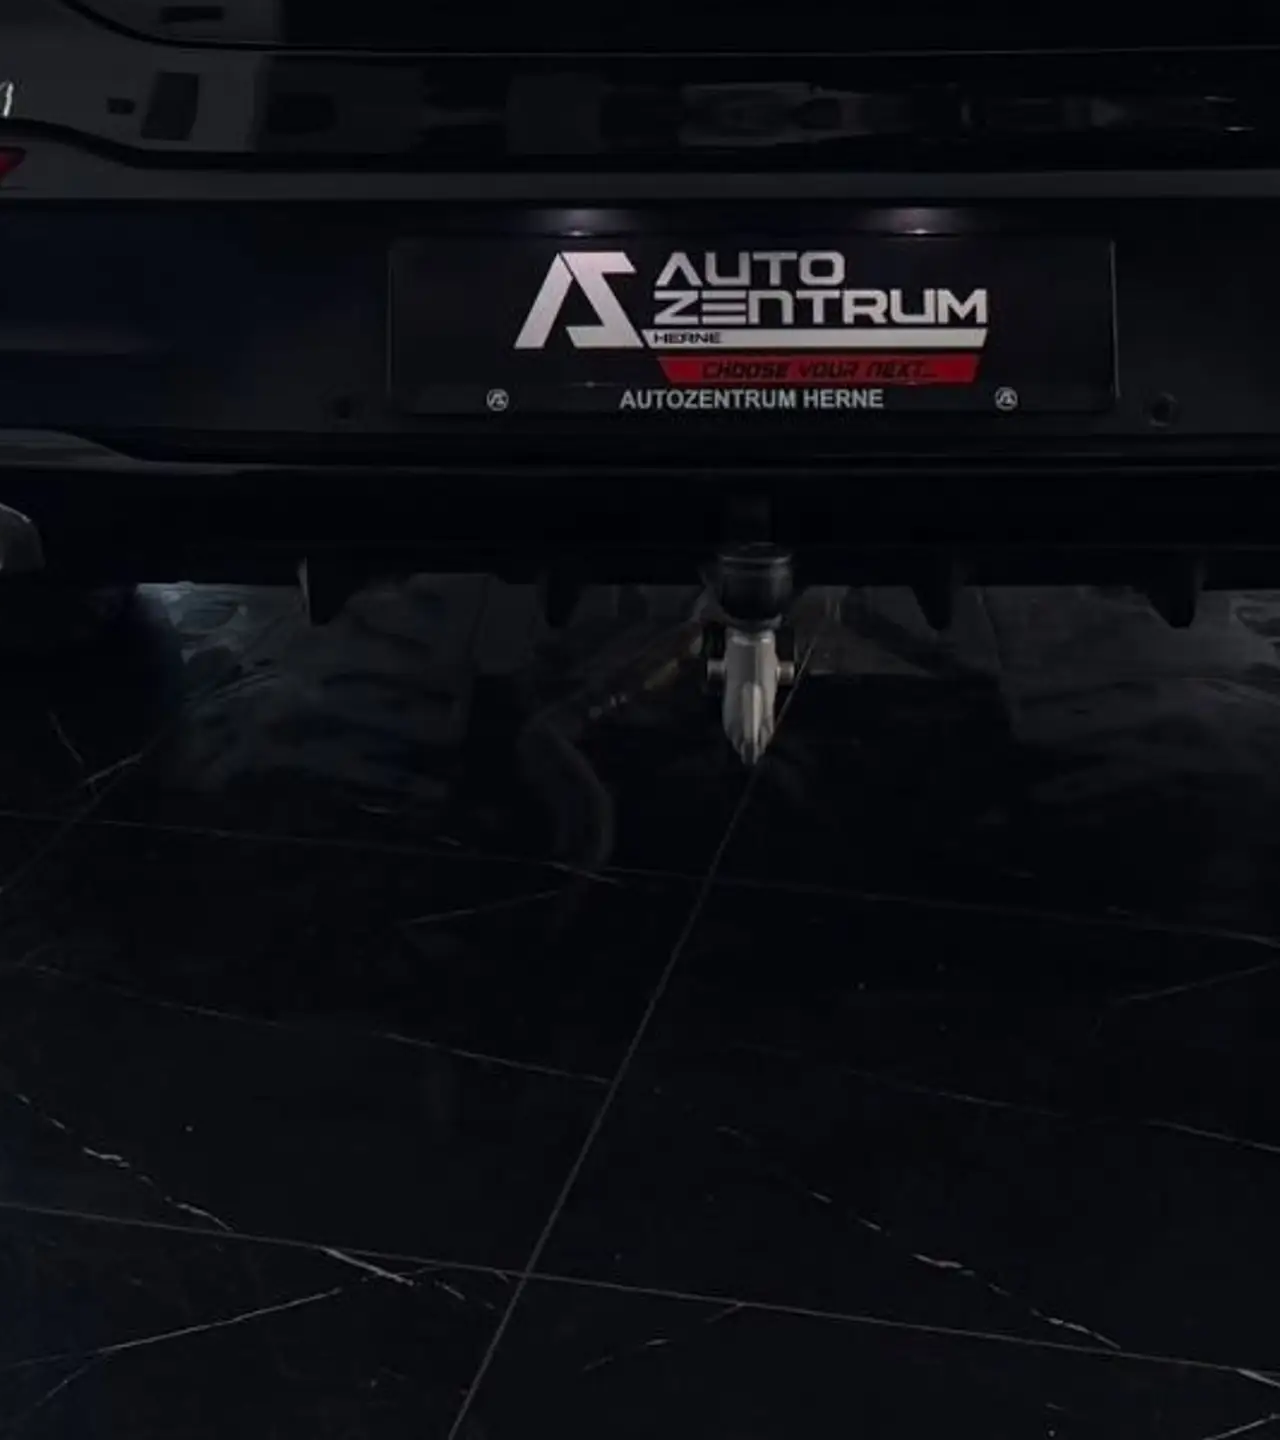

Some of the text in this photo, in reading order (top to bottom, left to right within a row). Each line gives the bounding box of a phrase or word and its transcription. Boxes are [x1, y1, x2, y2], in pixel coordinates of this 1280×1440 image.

[654, 252, 845, 286] AUTO
[652, 288, 988, 325] ZENTRUM
[653, 330, 722, 344] HERNE
[701, 360, 791, 379] CHOOSE
[798, 360, 860, 379] YOUR
[620, 388, 885, 410] AUTOZENTRUM HERNE
